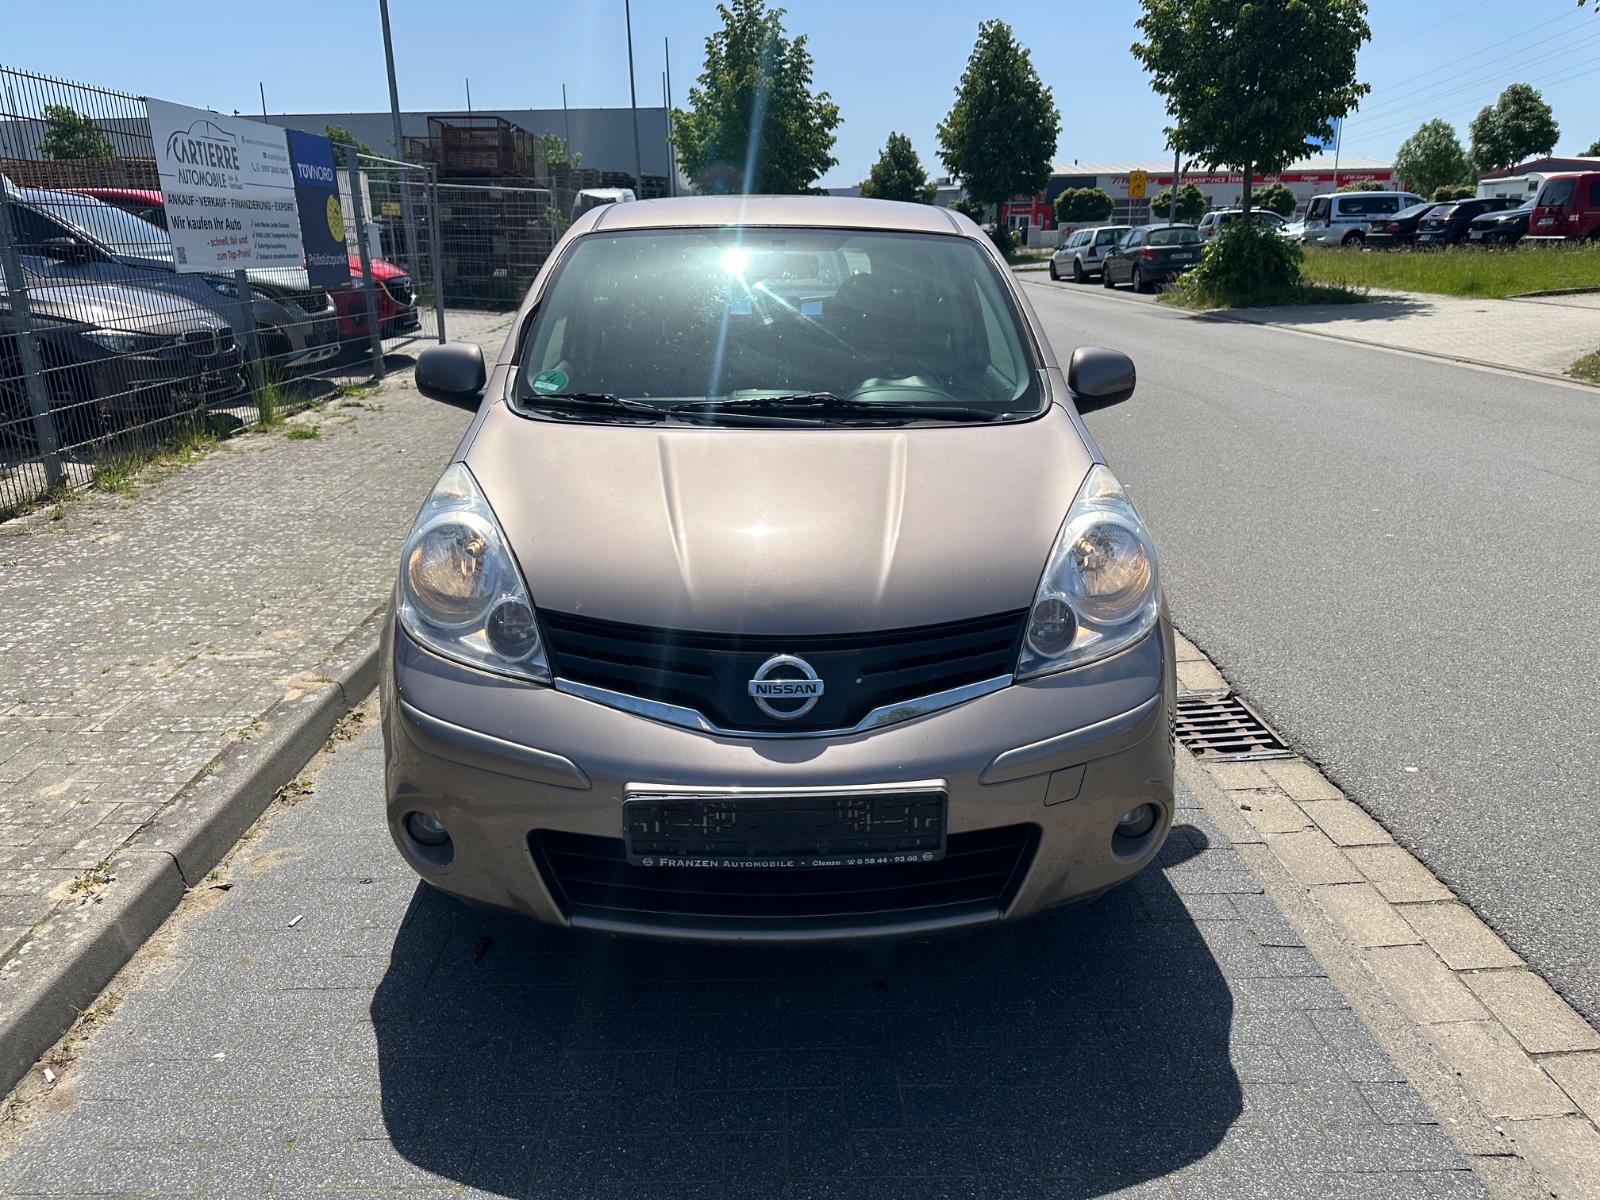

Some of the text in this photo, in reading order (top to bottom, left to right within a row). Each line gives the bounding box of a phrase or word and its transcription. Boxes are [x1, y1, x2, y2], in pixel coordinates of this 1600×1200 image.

[173, 136, 240, 170] CARTIERRE
[178, 168, 227, 188] AUTOMOBILE
[168, 194, 194, 206] ANKAUF
[199, 196, 227, 208] VERKAUF
[231, 199, 272, 211] FINANZIERUNG
[275, 202, 294, 212] EXPORT
[171, 216, 185, 229] Wir
[186, 216, 213, 230] kaufen
[213, 217, 224, 230] Ihr
[225, 218, 242, 231] Auto
[755, 684, 817, 694] NISSAN
